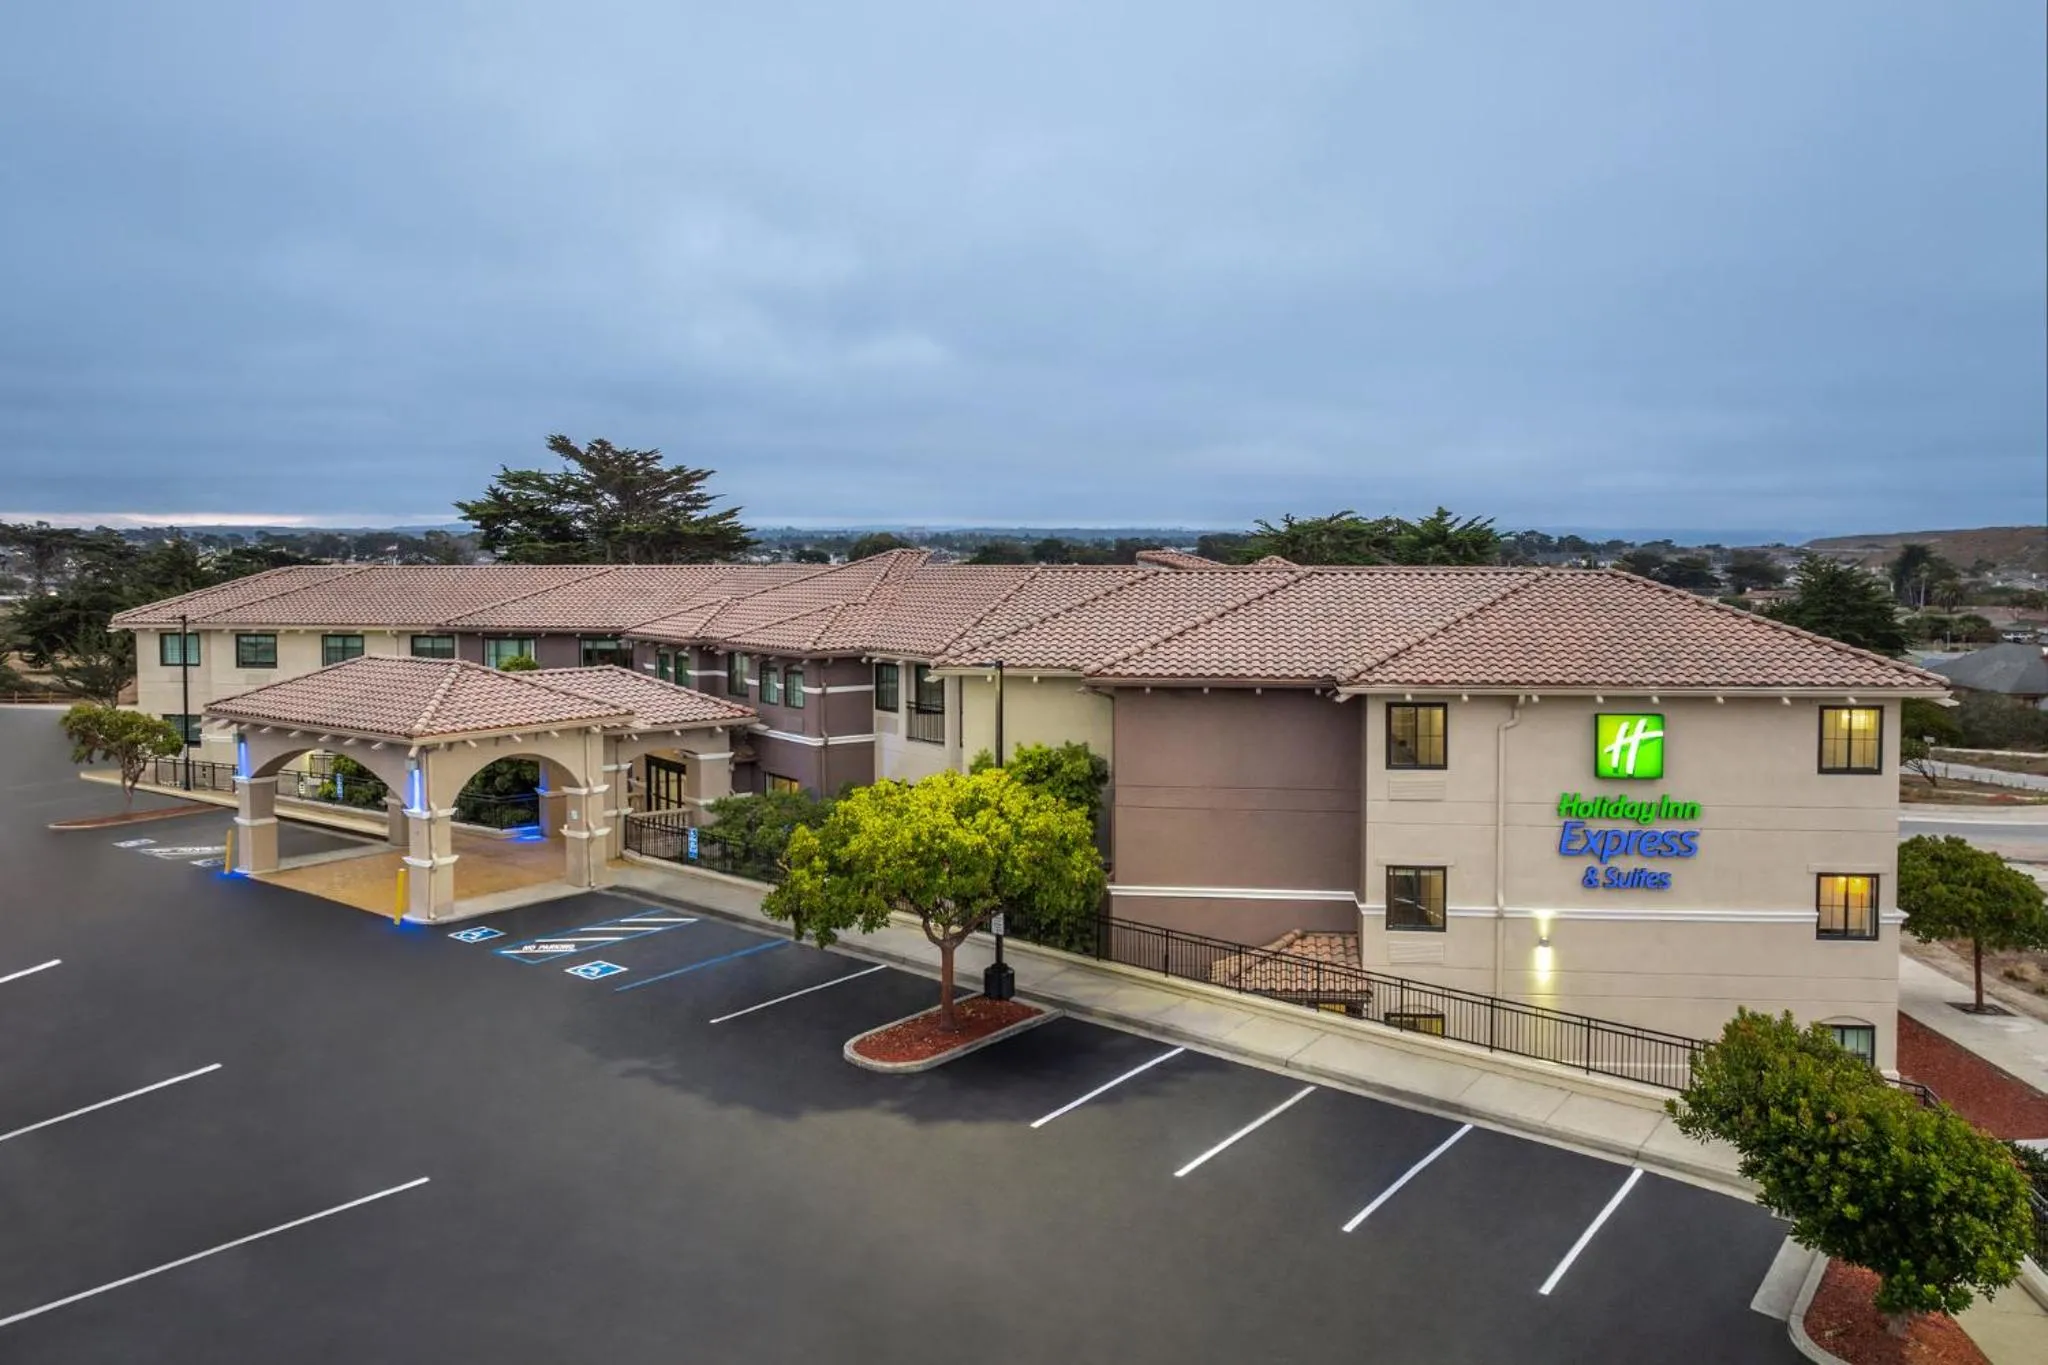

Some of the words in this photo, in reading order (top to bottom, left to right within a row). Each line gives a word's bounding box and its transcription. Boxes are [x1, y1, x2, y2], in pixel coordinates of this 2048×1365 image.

[1558, 793, 1657, 826] Holiday
[1659, 794, 1703, 821] Inn
[1559, 821, 1700, 864] Express
[1582, 866, 1600, 888] &
[1603, 867, 1672, 889] Suites
